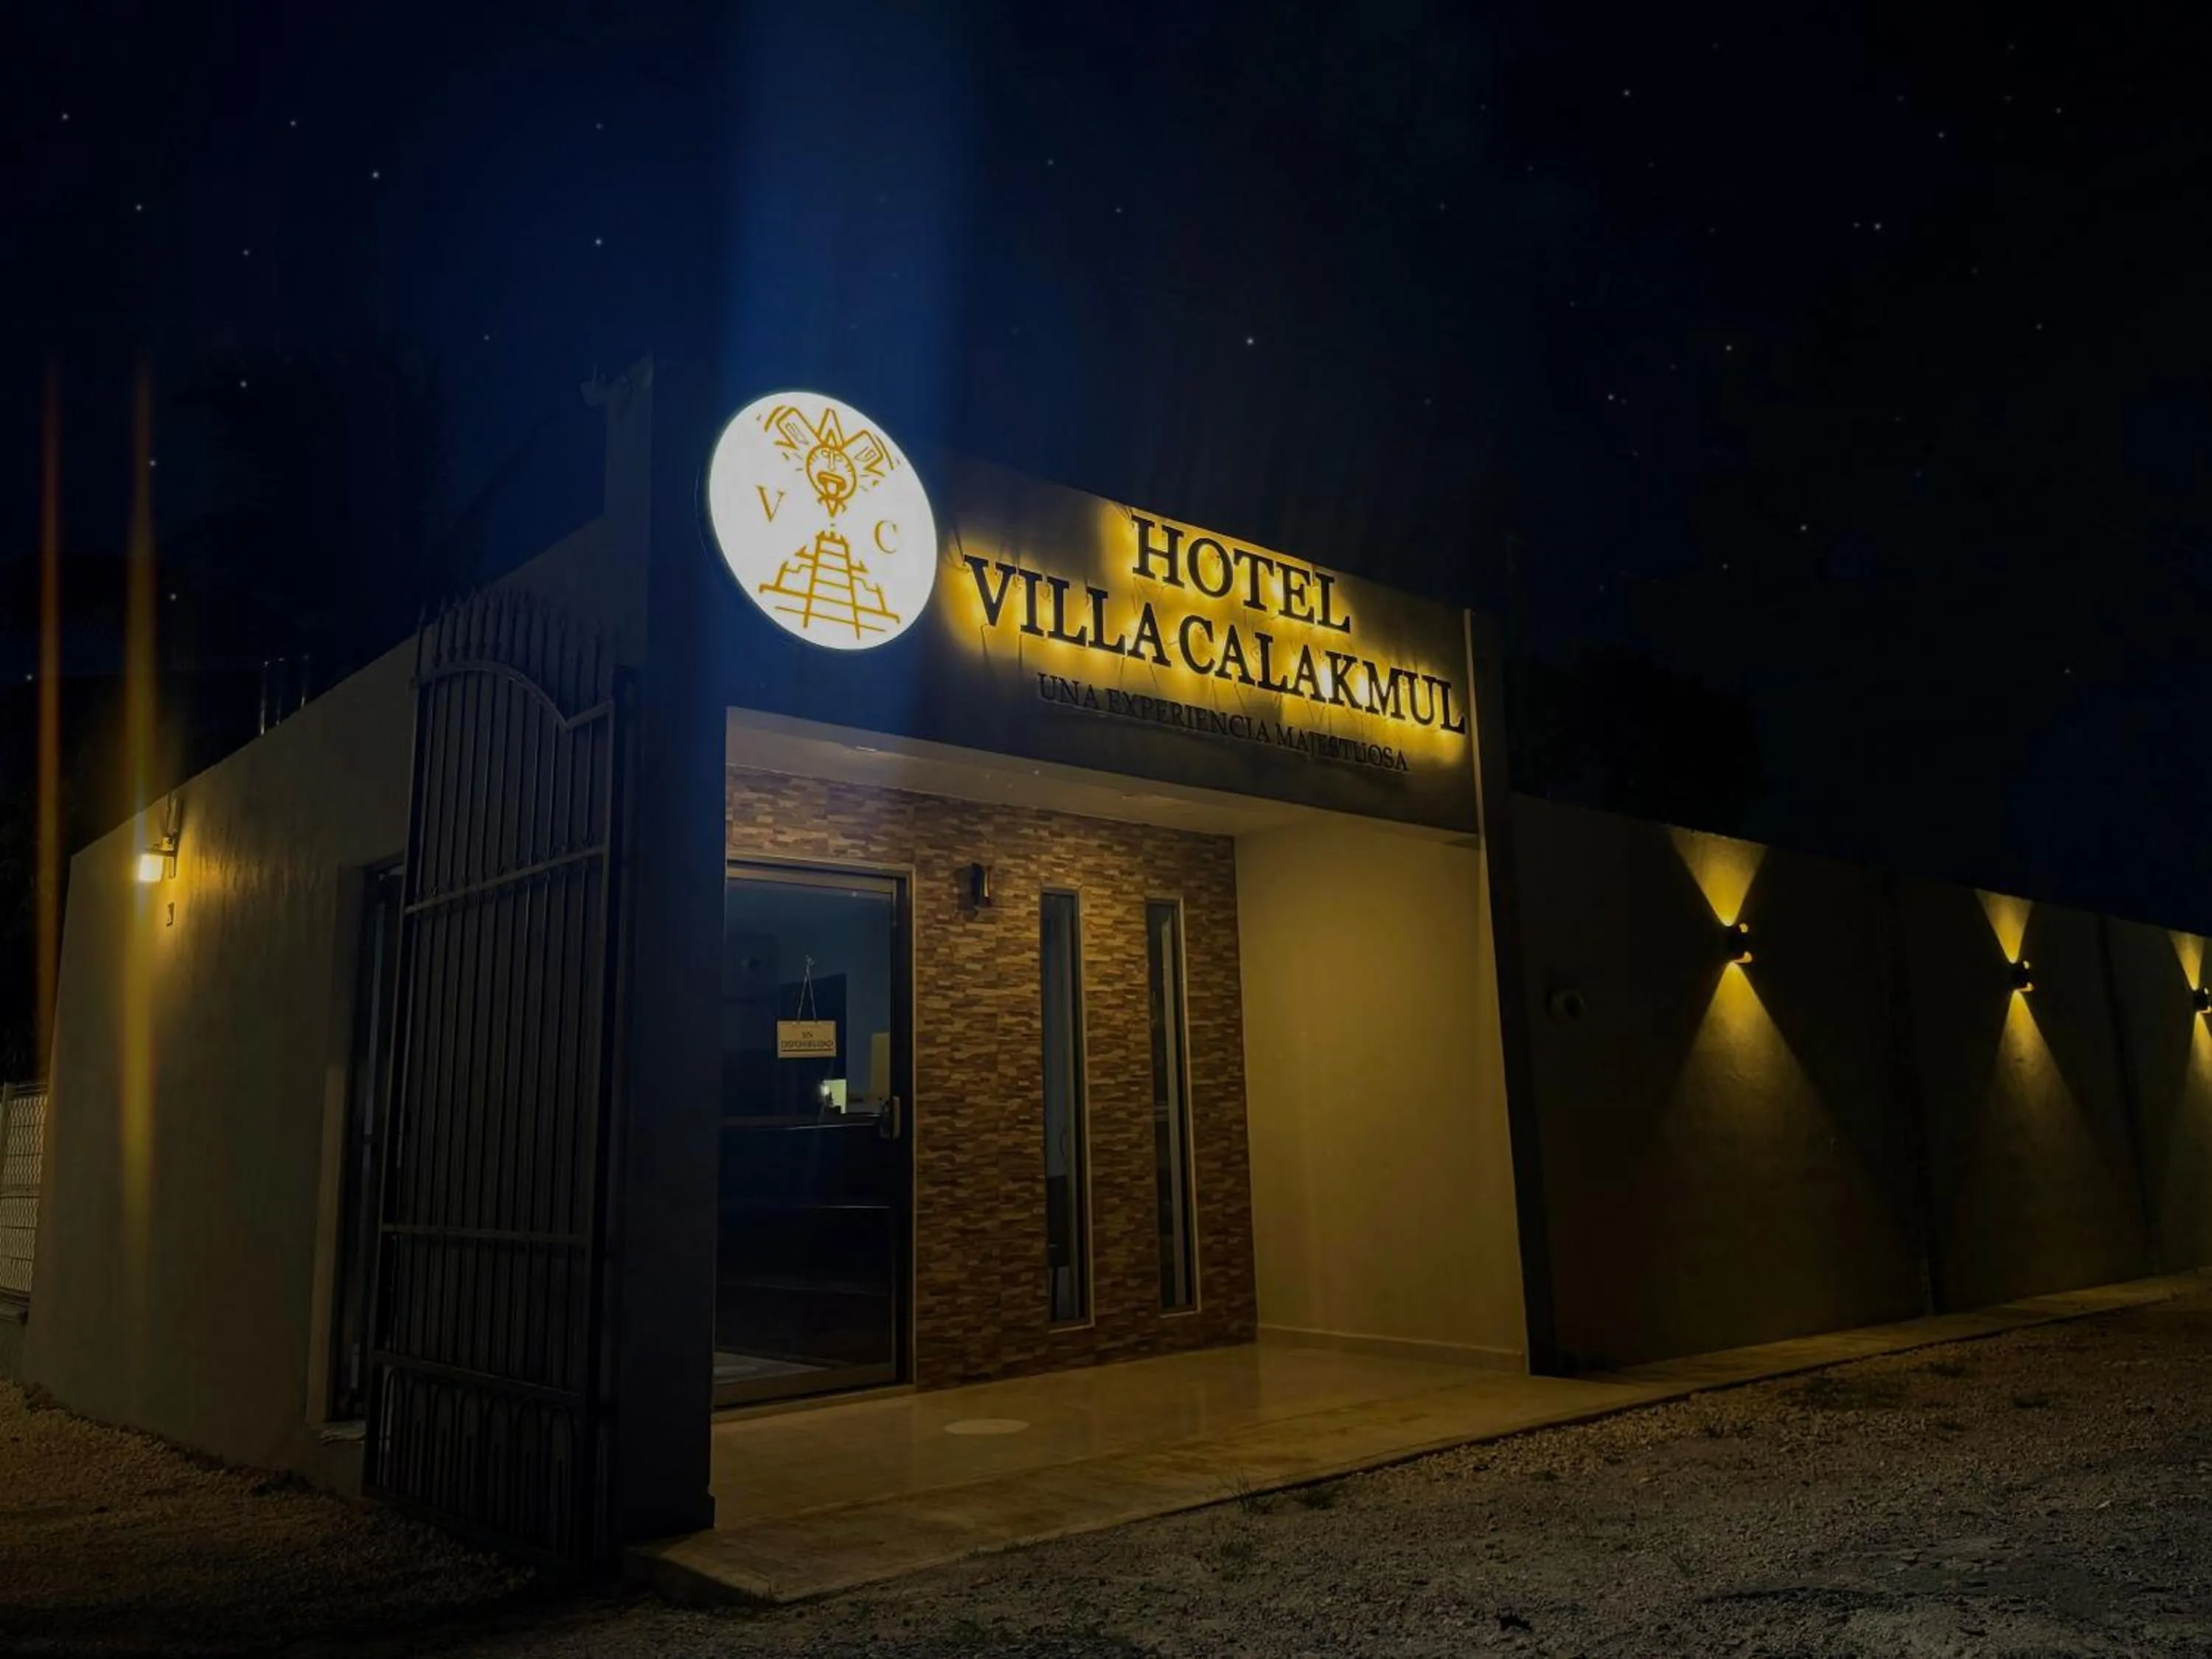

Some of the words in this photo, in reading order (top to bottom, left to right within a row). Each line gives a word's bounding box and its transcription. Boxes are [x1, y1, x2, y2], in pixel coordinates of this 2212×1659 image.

[757, 486, 785, 522] V
[874, 520, 898, 554] C
[1131, 515, 1351, 633] HOTEL
[964, 554, 1171, 667] VILLA
[1179, 614, 1466, 734] CALAKMUL
[1037, 672, 1099, 711] UNA
[1107, 688, 1270, 742] EXPERIENCIA
[1276, 722, 1410, 772] MAJESTUOSA
